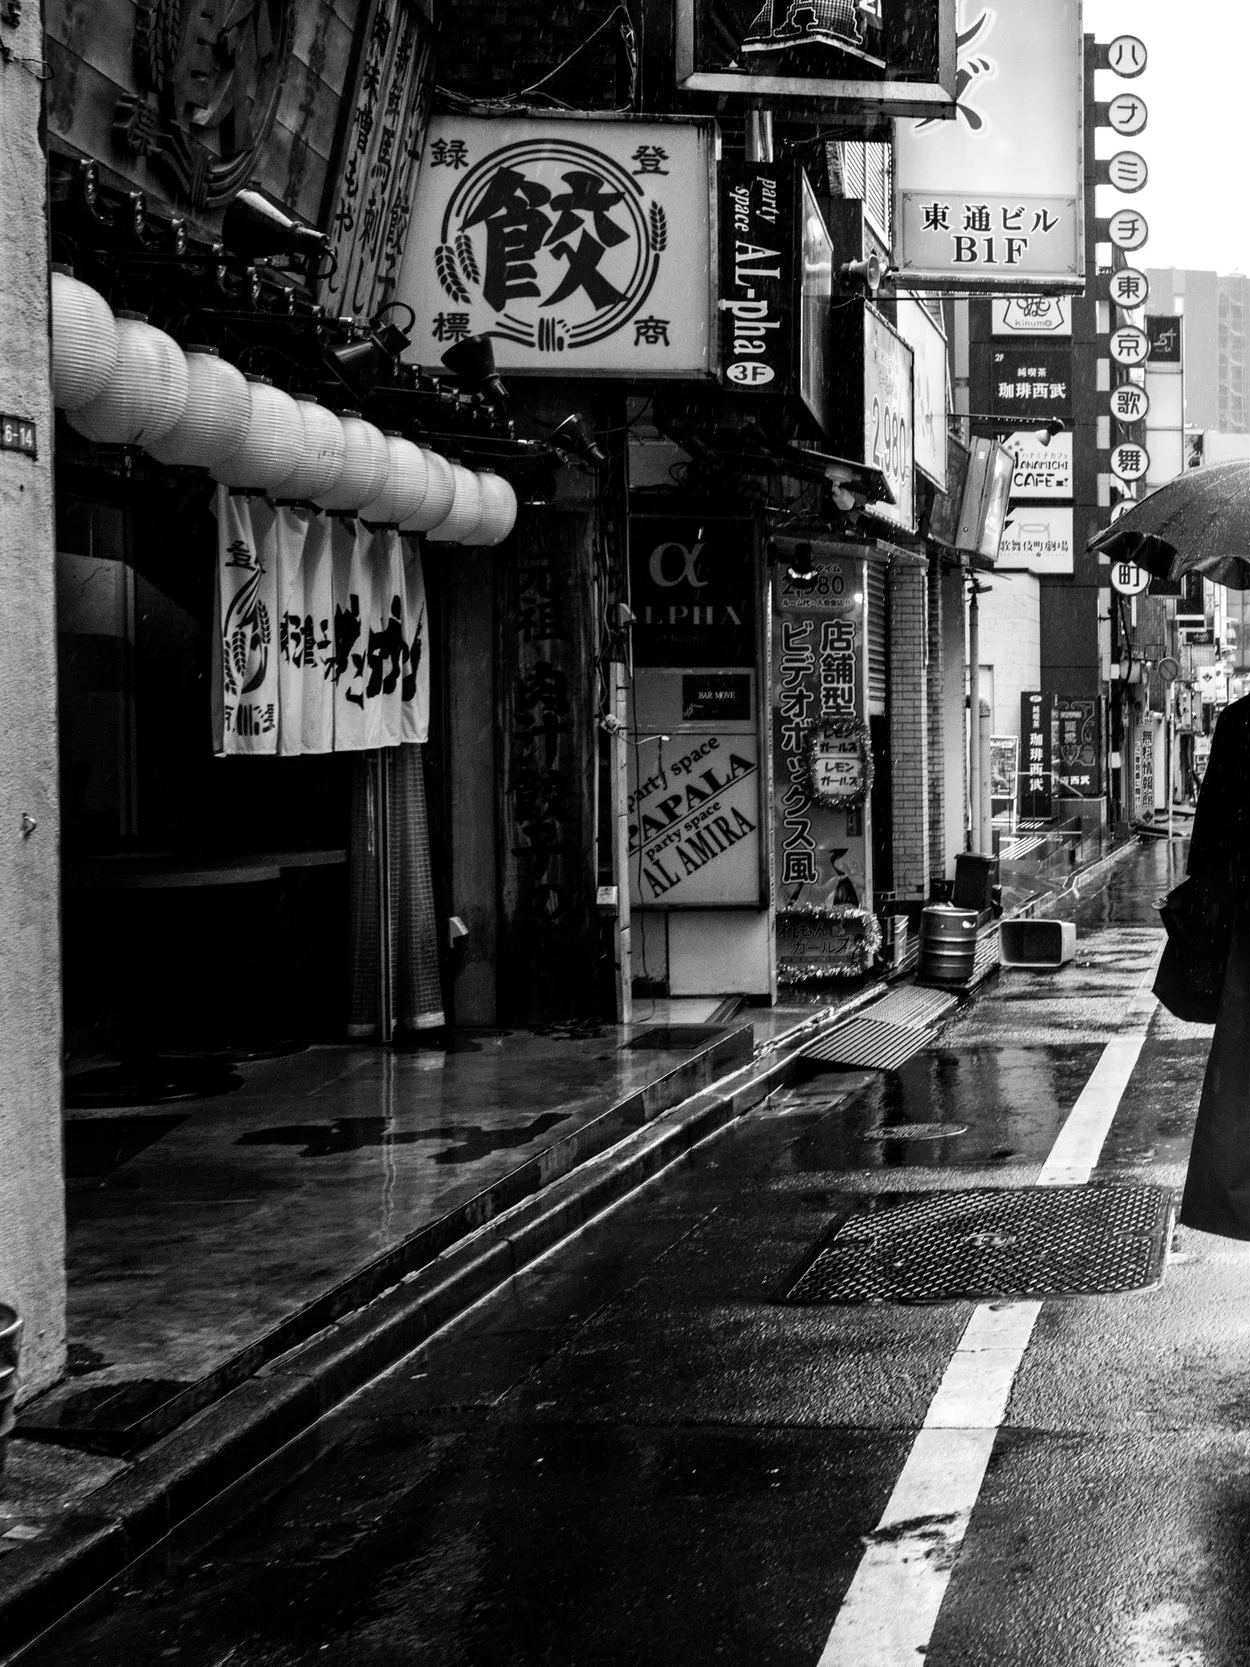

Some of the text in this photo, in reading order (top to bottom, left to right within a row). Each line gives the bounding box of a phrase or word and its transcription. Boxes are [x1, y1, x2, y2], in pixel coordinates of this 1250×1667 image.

[430, 138, 470, 170] 録
[631, 145, 670, 176] 登
[730, 186, 750, 232] space
[756, 176, 780, 224] party
[921, 203, 1059, 233] 東通ビル
[457, 166, 631, 313] 餃
[953, 236, 1028, 264] B1F
[719, 240, 781, 354] AL-pha
[432, 312, 472, 342] 標
[633, 315, 671, 347] 商
[1115, 44, 1142, 588] ハナミチ東京歌舞町
[733, 364, 767, 382] 3F
[995, 354, 1004, 362] 2F
[1017, 367, 1047, 378] 純喫茶
[998, 382, 1067, 399] 珈琲西武
[5, 424, 33, 447] 6-14
[1014, 473, 1055, 487] CAFE
[644, 605, 742, 626] LPHA
[820, 618, 856, 718] 店舗型
[628, 737, 720, 813] party space
[825, 762, 854, 772] レモン
[1029, 733, 1044, 791] 珈琲西武
[629, 754, 755, 851] PAPALA
[645, 801, 721, 861] party space
[643, 807, 756, 898] AL AMIRA
